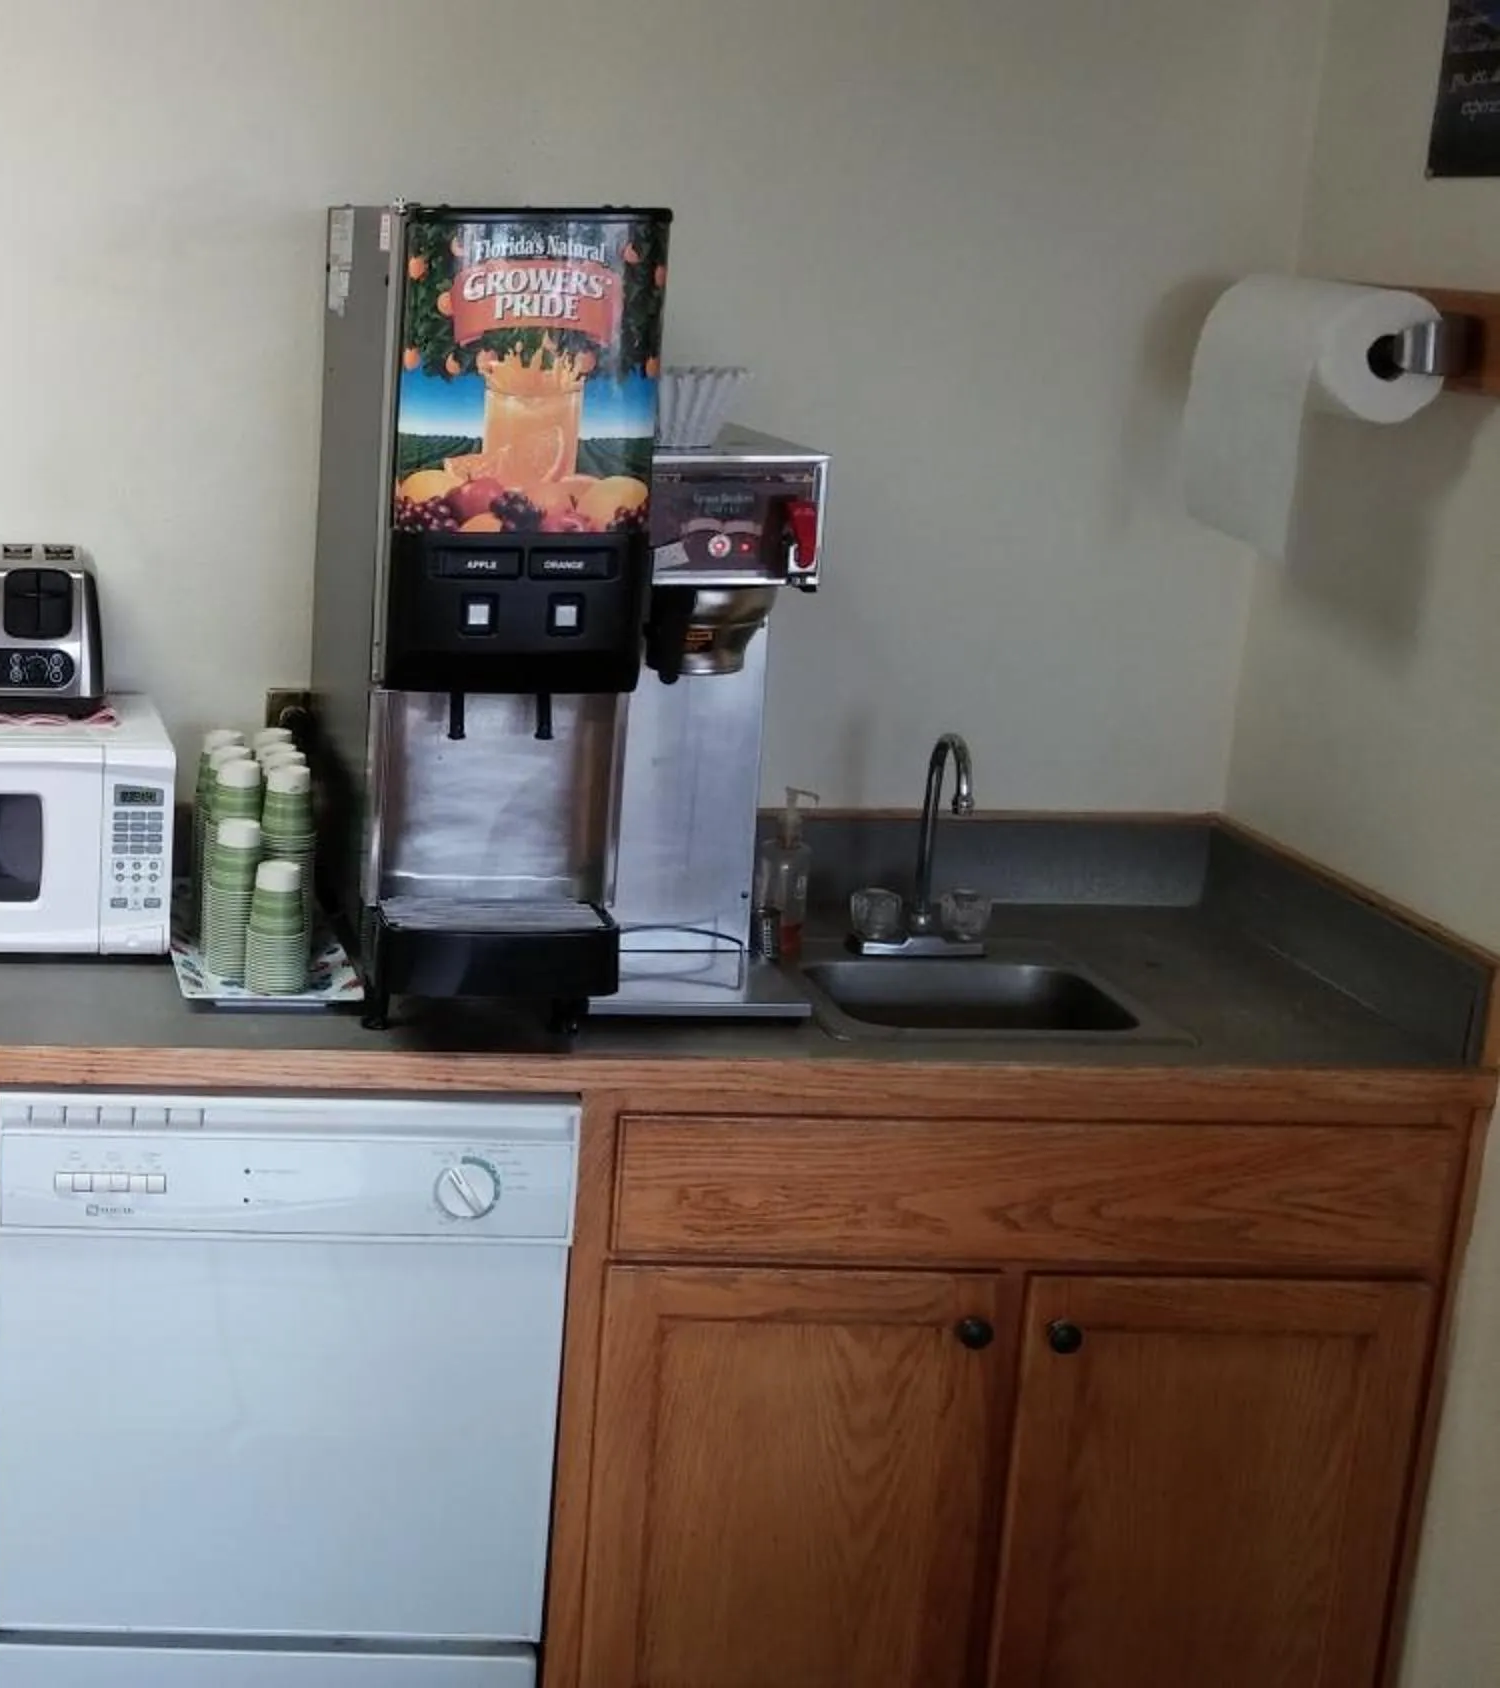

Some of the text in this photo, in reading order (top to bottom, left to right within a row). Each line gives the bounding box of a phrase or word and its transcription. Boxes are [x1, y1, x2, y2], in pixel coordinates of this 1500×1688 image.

[474, 231, 606, 263] Florida's Natural
[494, 293, 579, 321] PRIDE
[466, 560, 498, 570] APPLE
[543, 560, 585, 570] ORANGE
